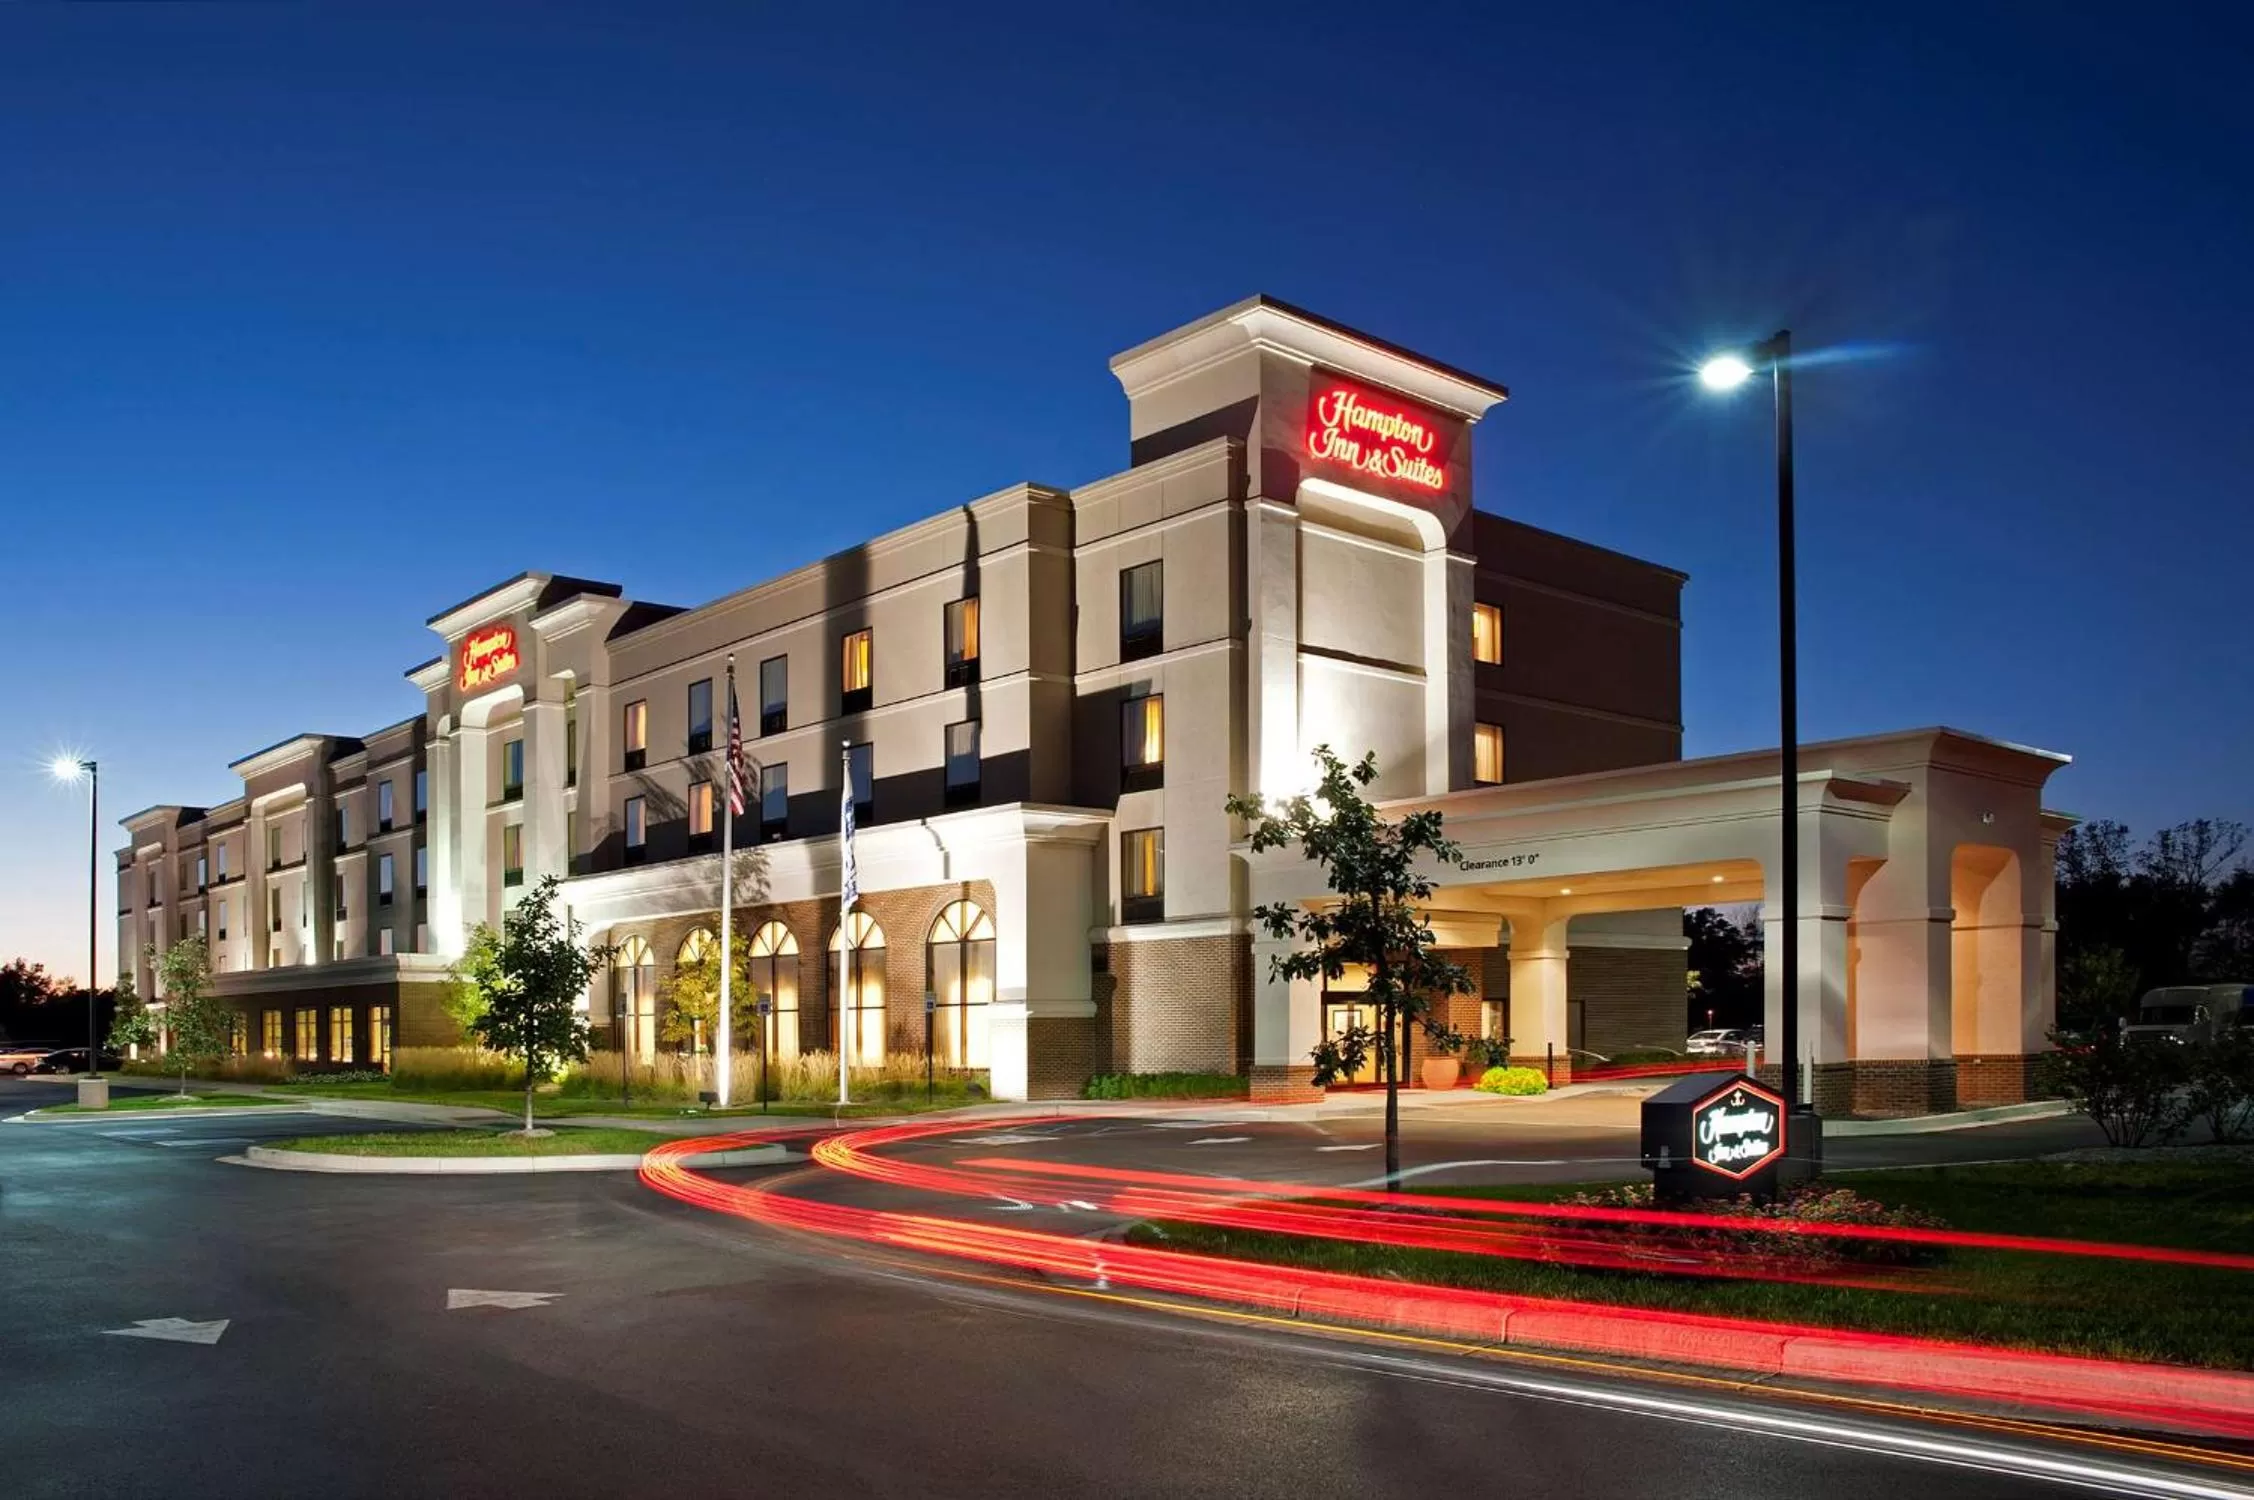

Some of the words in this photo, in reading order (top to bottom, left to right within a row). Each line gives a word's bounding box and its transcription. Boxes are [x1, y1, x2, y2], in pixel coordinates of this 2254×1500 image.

[1319, 391, 1433, 452] Hampton
[1309, 428, 1369, 469] Inn
[1384, 446, 1443, 489] Suites
[1460, 858, 1509, 871] Clearance
